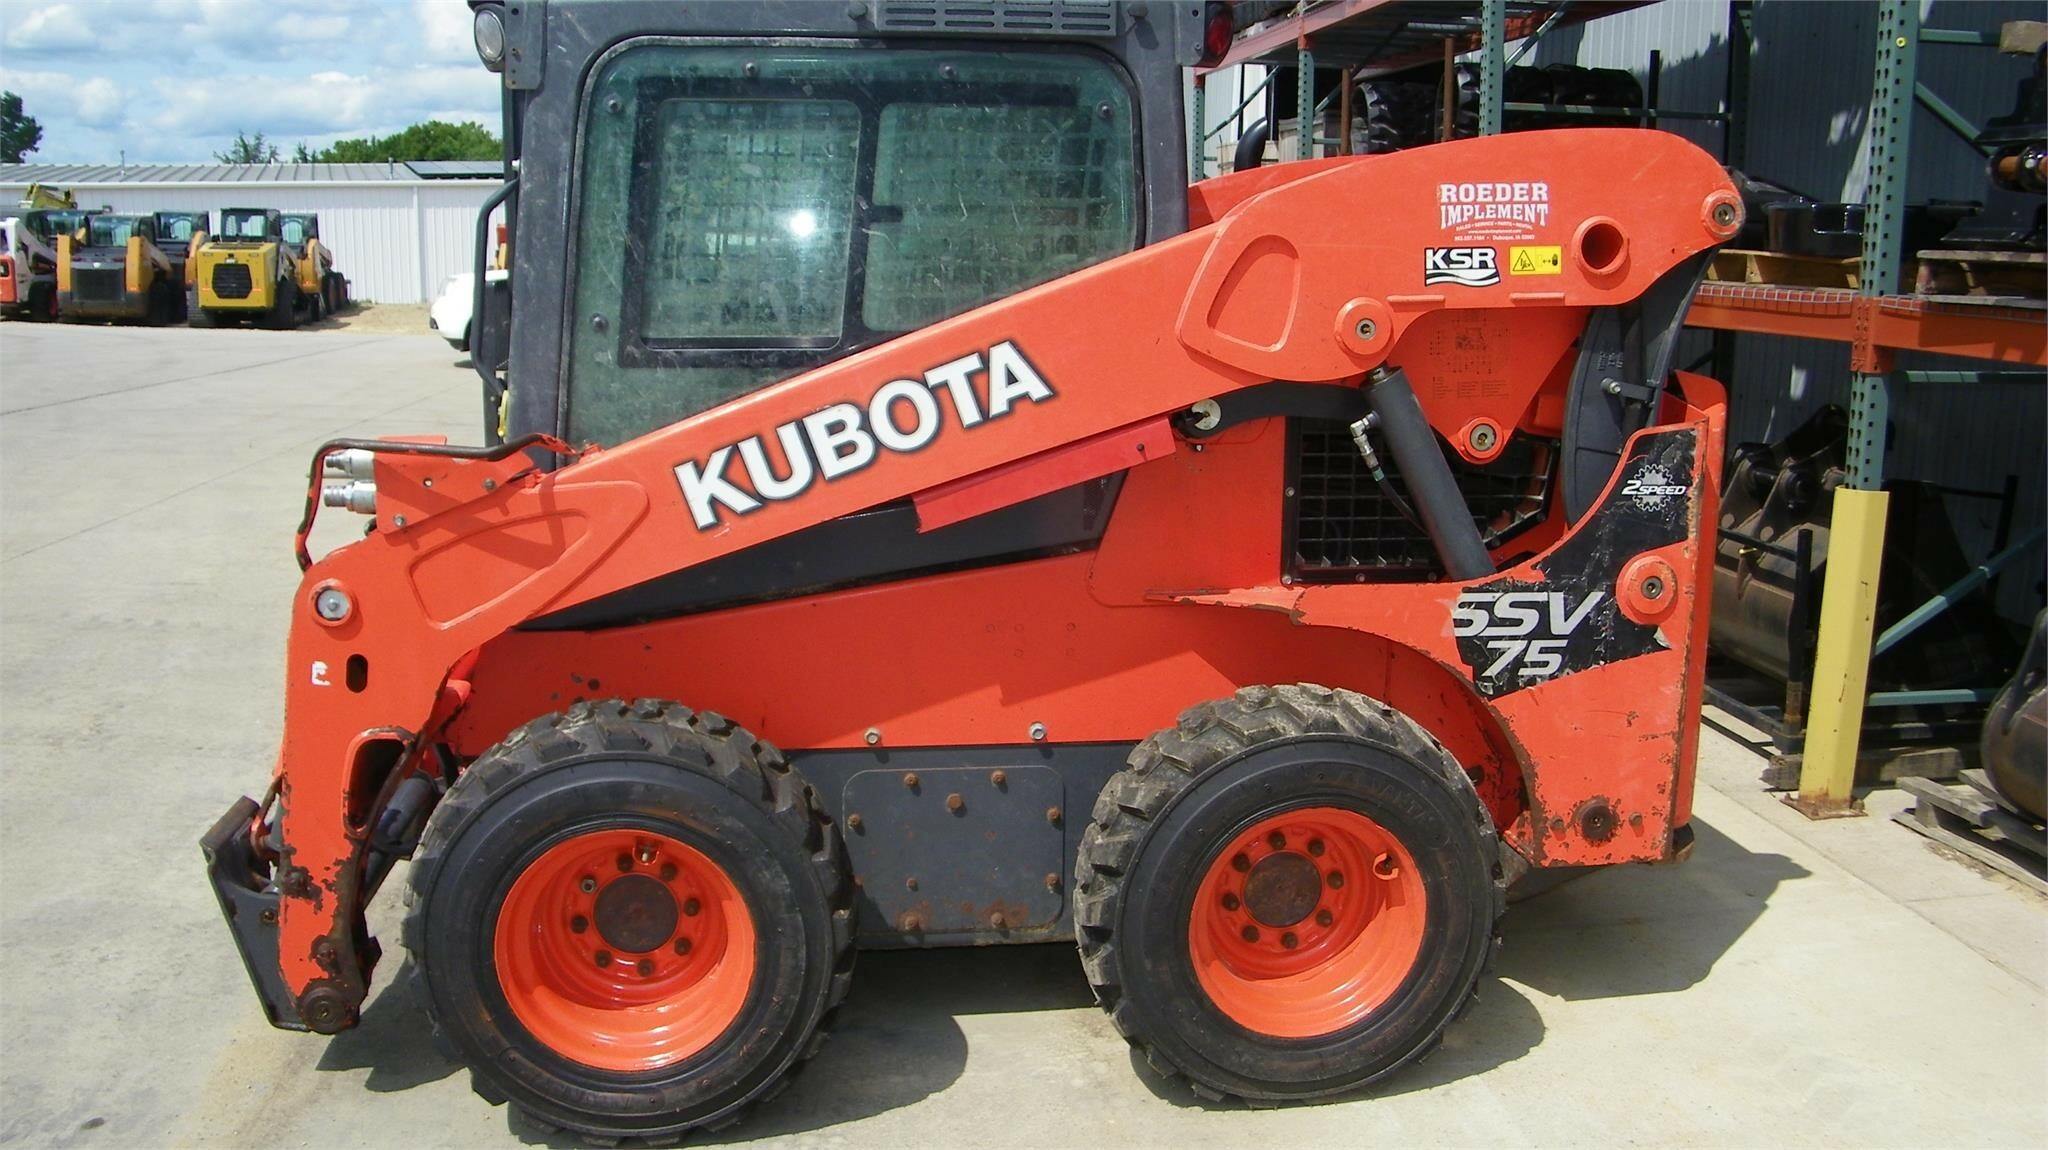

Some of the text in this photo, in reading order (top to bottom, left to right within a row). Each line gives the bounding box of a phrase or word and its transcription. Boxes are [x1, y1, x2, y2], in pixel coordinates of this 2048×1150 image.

[1440, 182, 1549, 203] ROEDER
[1440, 203, 1549, 230] IMPLEMENT
[1426, 248, 1496, 269] KSR
[673, 340, 1056, 530] KUBOTA
[1453, 591, 1606, 637] SSV
[1481, 639, 1570, 677] 75
